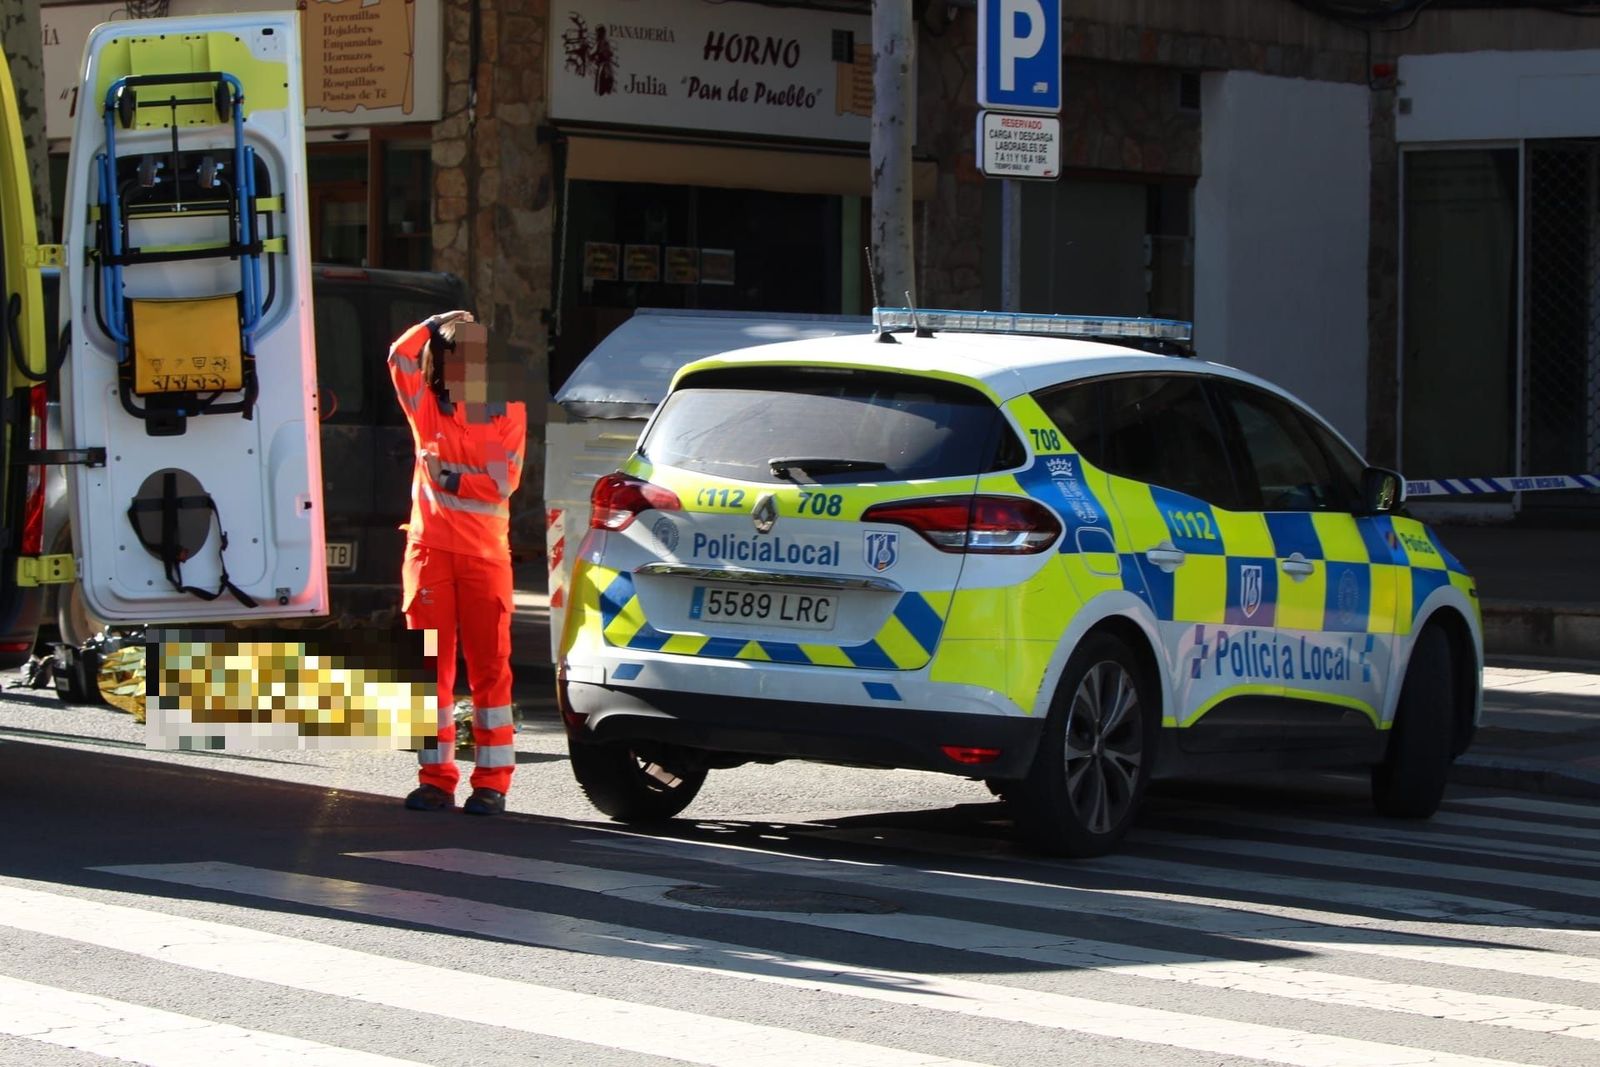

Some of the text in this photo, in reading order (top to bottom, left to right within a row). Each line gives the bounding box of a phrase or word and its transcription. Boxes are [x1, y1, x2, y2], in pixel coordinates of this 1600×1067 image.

[323, 11, 381, 23] Perronillas
[323, 24, 373, 37] Hojaldres
[609, 24, 675, 43] PANADERÍA
[323, 37, 383, 50] Empanadas
[703, 31, 800, 68] HORNO
[1000, 0, 1046, 91] P
[323, 51, 373, 62] Hornazos
[323, 63, 385, 75] Mantecados
[323, 77, 377, 89] Rosquillas
[624, 73, 667, 96] Julia
[323, 91, 356, 101] Pastas
[359, 90, 370, 100] de
[727, 79, 748, 103] de
[1001, 118, 1042, 129] RESERVADO
[989, 129, 1053, 141] CARGA Y DESCARGA
[995, 141, 1048, 153] LABORABLES DE
[1000, 152, 1005, 161] A
[1015, 153, 1020, 162] Y
[1028, 155, 1033, 164] A
[1030, 428, 1061, 451] 708
[706, 488, 842, 516] 112 708
[1174, 510, 1216, 540] 112
[708, 590, 830, 623] 5589 LRC
[1216, 630, 1352, 681] Policía Local
